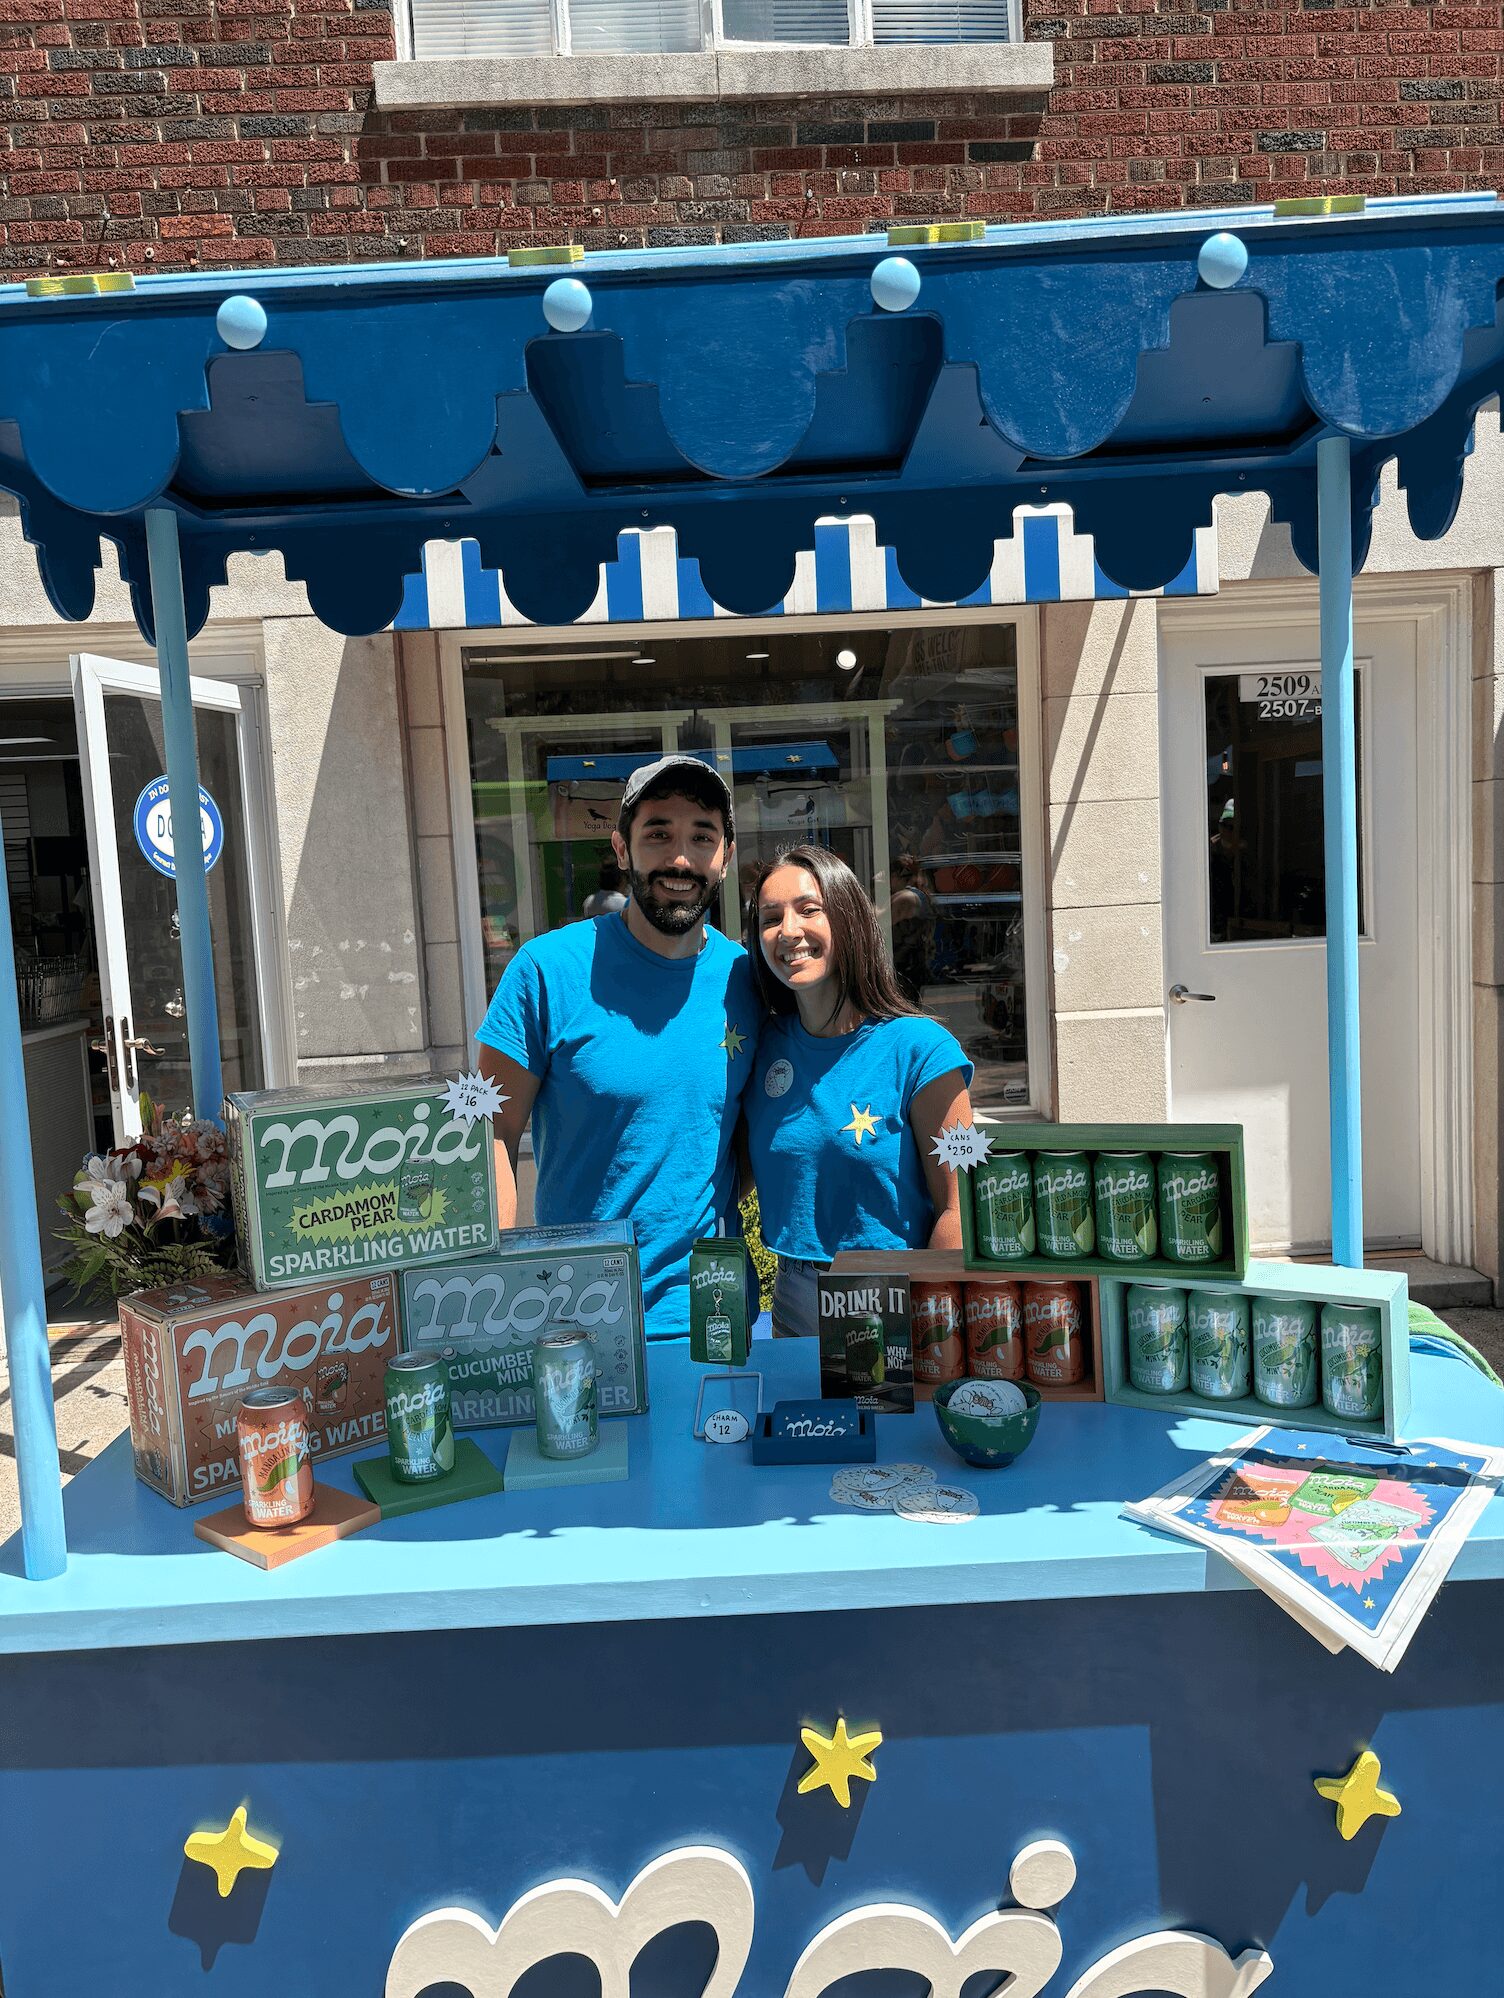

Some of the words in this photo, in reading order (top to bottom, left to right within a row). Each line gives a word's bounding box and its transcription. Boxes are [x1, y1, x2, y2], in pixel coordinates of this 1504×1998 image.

[1257, 675, 1311, 697] 2509
[1311, 684, 1322, 695] A
[148, 787, 158, 801] IN
[158, 784, 169, 795] DO
[584, 821, 601, 832] Yoga
[602, 820, 617, 831] Dog
[471, 1085, 488, 1095] PACK
[298, 1191, 396, 1230] CARDAMOM
[1182, 1211, 1203, 1223] PEAR
[351, 1209, 396, 1232] PEAR
[270, 1237, 404, 1277] SPARKLING
[408, 1224, 487, 1253] WATER
[991, 1242, 1021, 1252] WATER
[1045, 1241, 1076, 1251] WATER
[1107, 1243, 1138, 1253] WATER
[1178, 1245, 1209, 1255] WATER
[820, 1288, 883, 1318] DRINK
[888, 1287, 906, 1315] IT
[887, 1346, 907, 1360] WHY
[887, 1356, 903, 1370] NOT
[499, 1366, 534, 1386] MINT
[451, 1390, 535, 1422] ARKLIN
[555, 1437, 589, 1450] WATER
[402, 1463, 437, 1475] WATER
[256, 1505, 294, 1519] WATER
